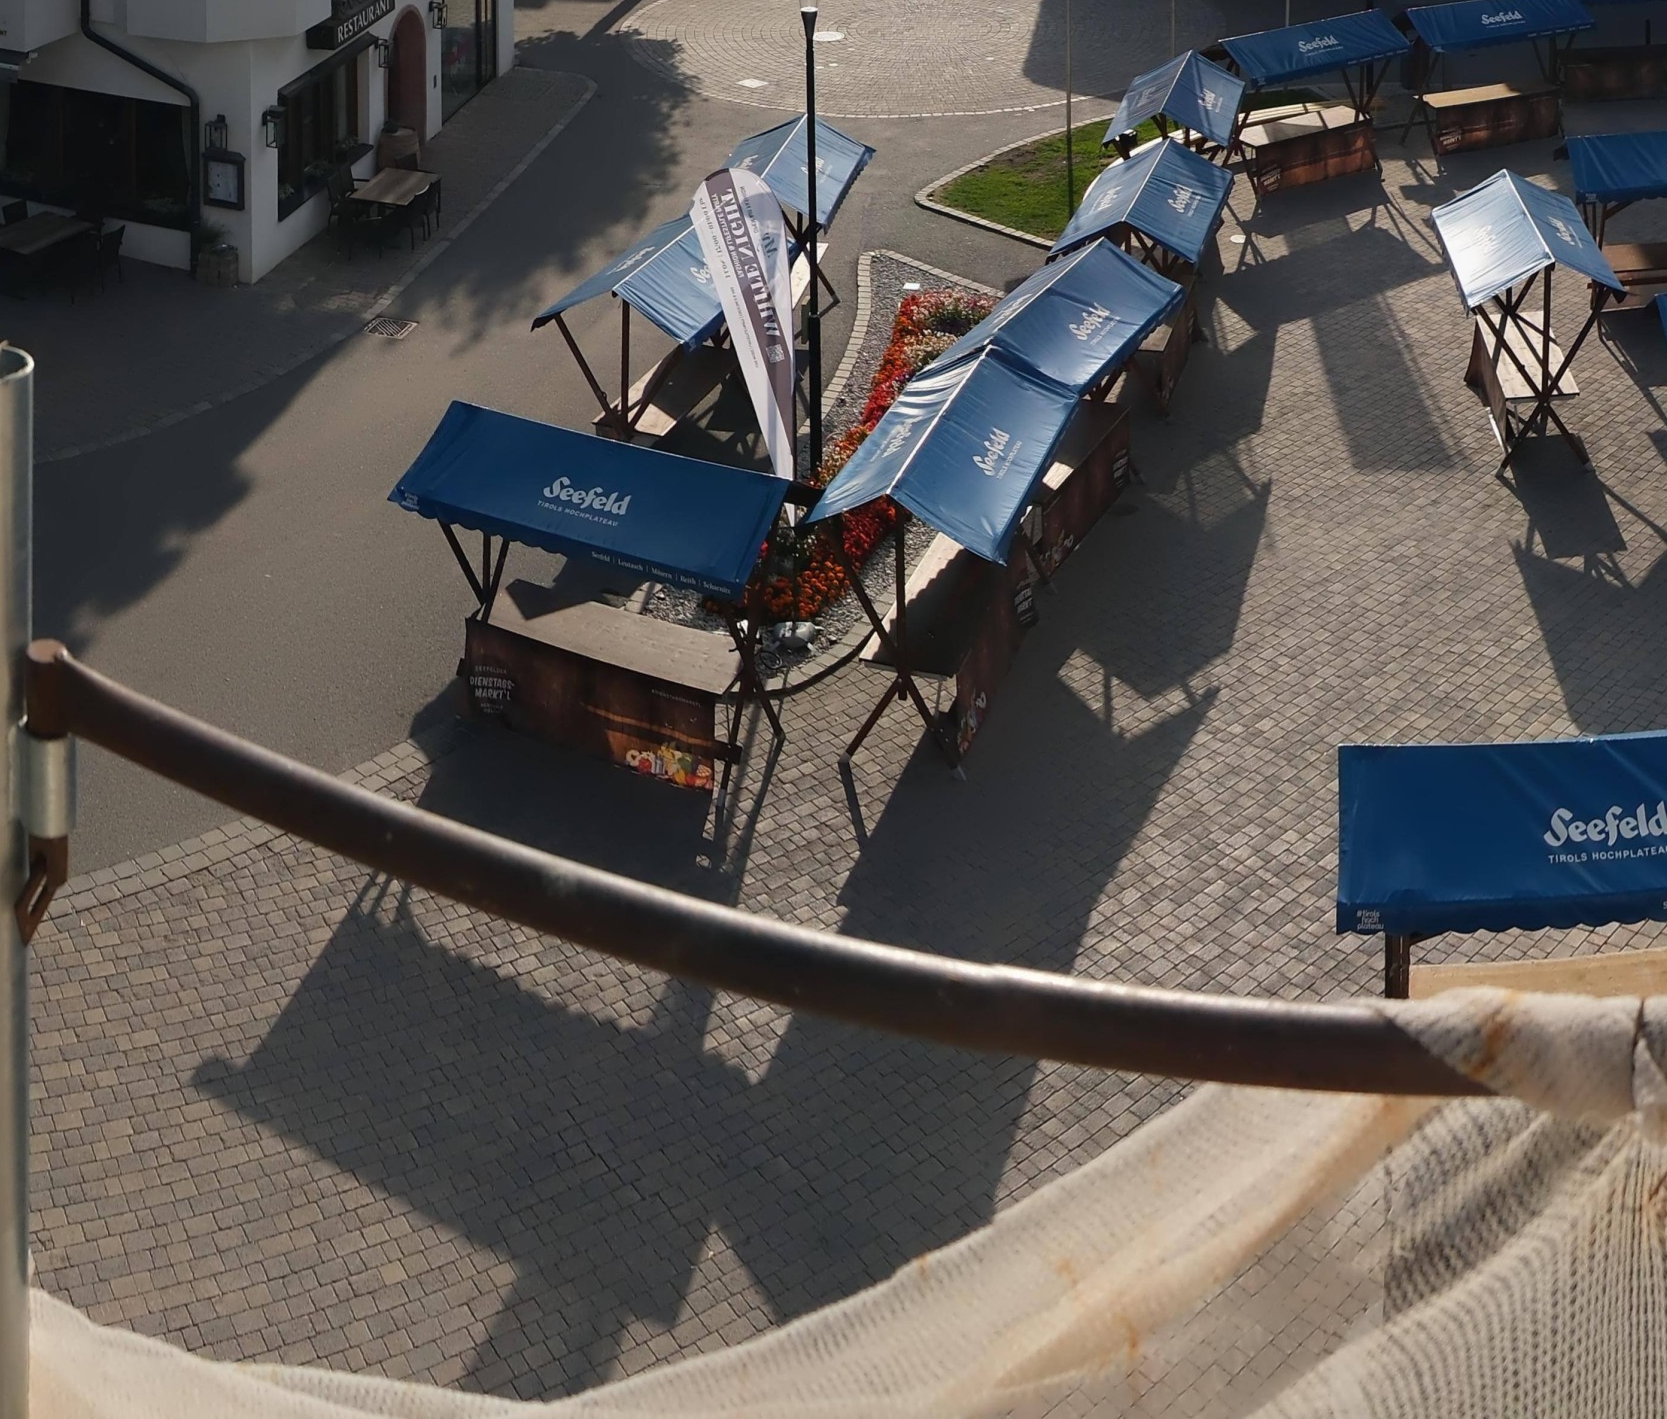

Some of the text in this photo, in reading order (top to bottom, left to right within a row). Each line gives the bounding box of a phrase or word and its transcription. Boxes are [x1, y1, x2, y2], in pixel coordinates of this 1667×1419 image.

[1481, 10, 1523, 25] Seefeld
[1298, 35, 1339, 53] Seefeld
[1167, 183, 1193, 214] Seefeld
[1069, 302, 1112, 342] Seefeld
[972, 427, 1010, 477] Seefeld
[543, 476, 632, 516] Seefeld
[537, 499, 619, 527] TIROLS HOCHPLATEAU
[1548, 852, 1588, 864] TIROLS
